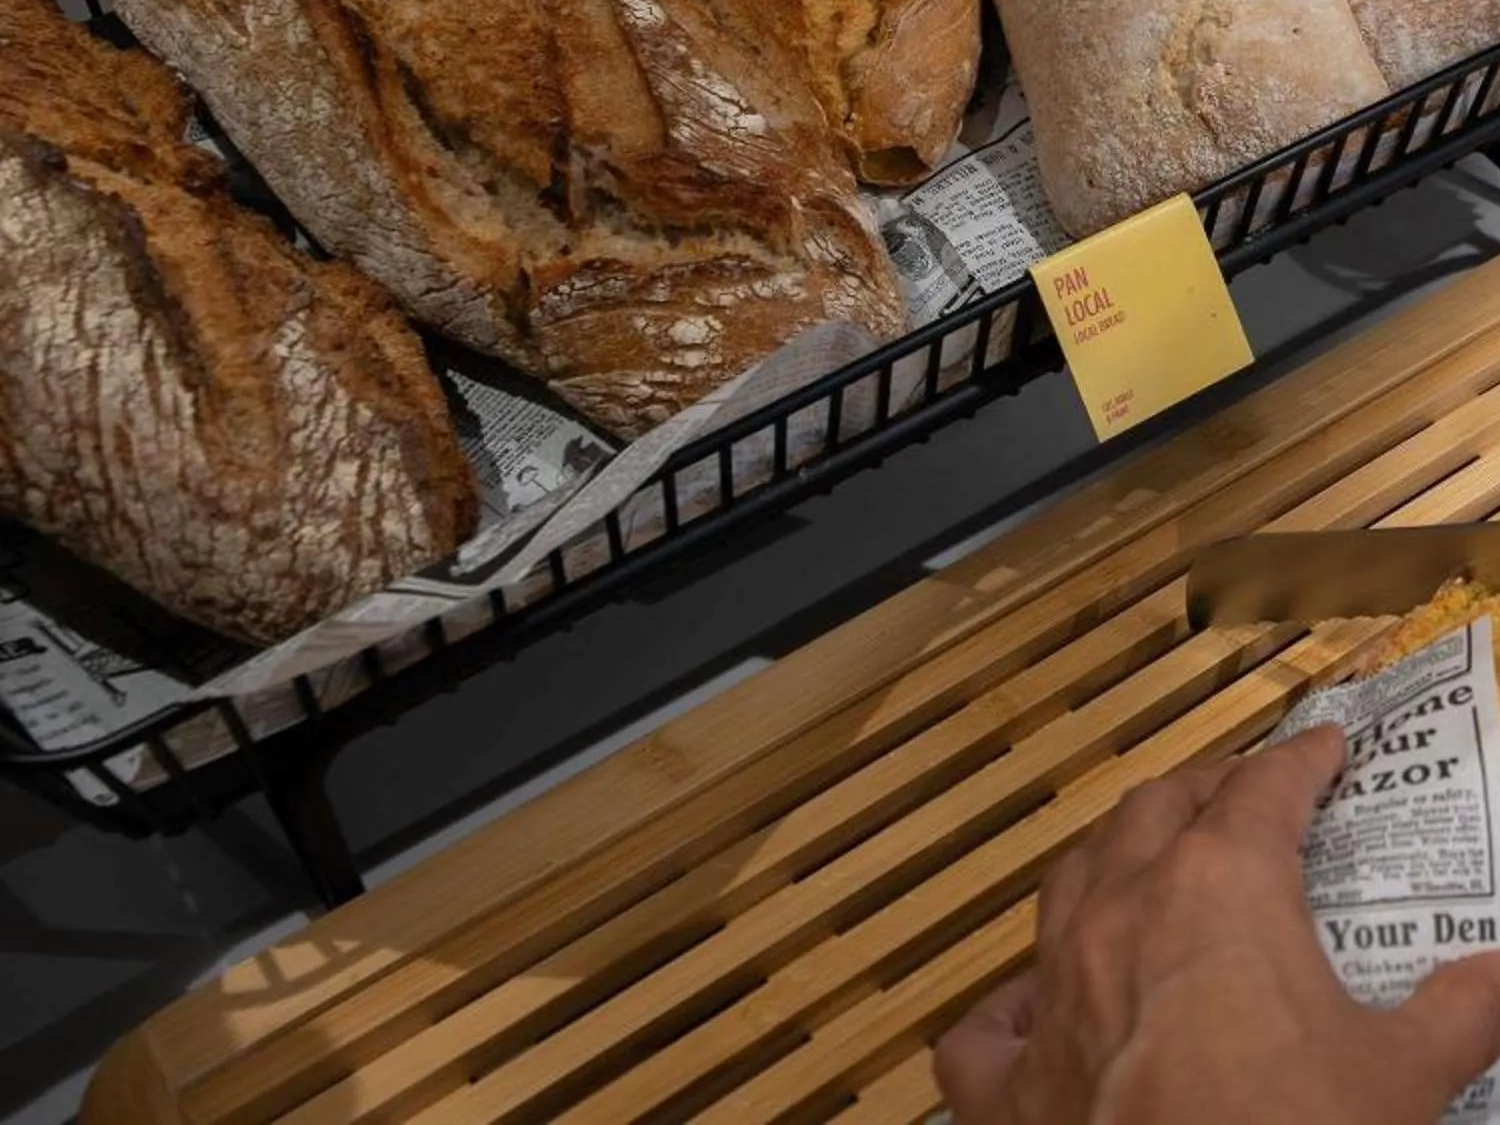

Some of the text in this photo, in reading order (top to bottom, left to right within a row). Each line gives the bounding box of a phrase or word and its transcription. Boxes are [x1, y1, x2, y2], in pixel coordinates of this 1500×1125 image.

[1053, 266, 1089, 300] PAN
[1064, 286, 1115, 327] LOCAL
[1352, 684, 1474, 757] Hone
[1318, 756, 1459, 807] azor
[1325, 912, 1498, 953] Your Den
